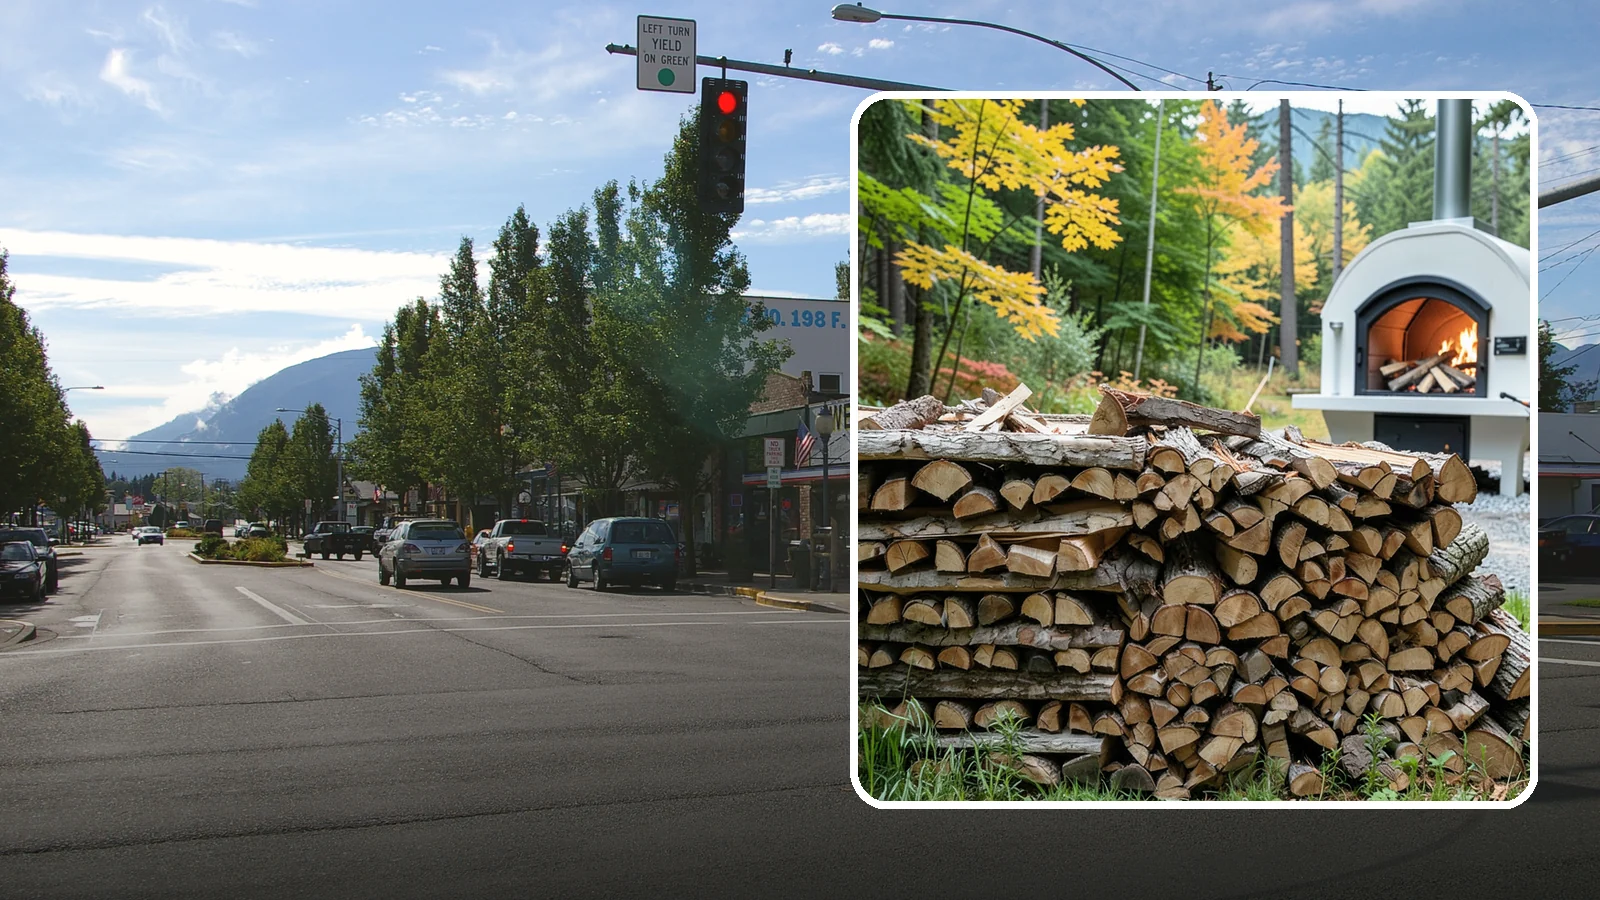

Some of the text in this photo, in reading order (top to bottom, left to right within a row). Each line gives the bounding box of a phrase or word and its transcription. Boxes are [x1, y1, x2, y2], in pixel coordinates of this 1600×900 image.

[643, 24, 690, 36] LEFT TURN
[652, 38, 682, 51] YIELD
[644, 53, 690, 66] ON GREEN
[757, 307, 786, 327] O.
[791, 309, 826, 328] 198
[831, 311, 847, 329] F.
